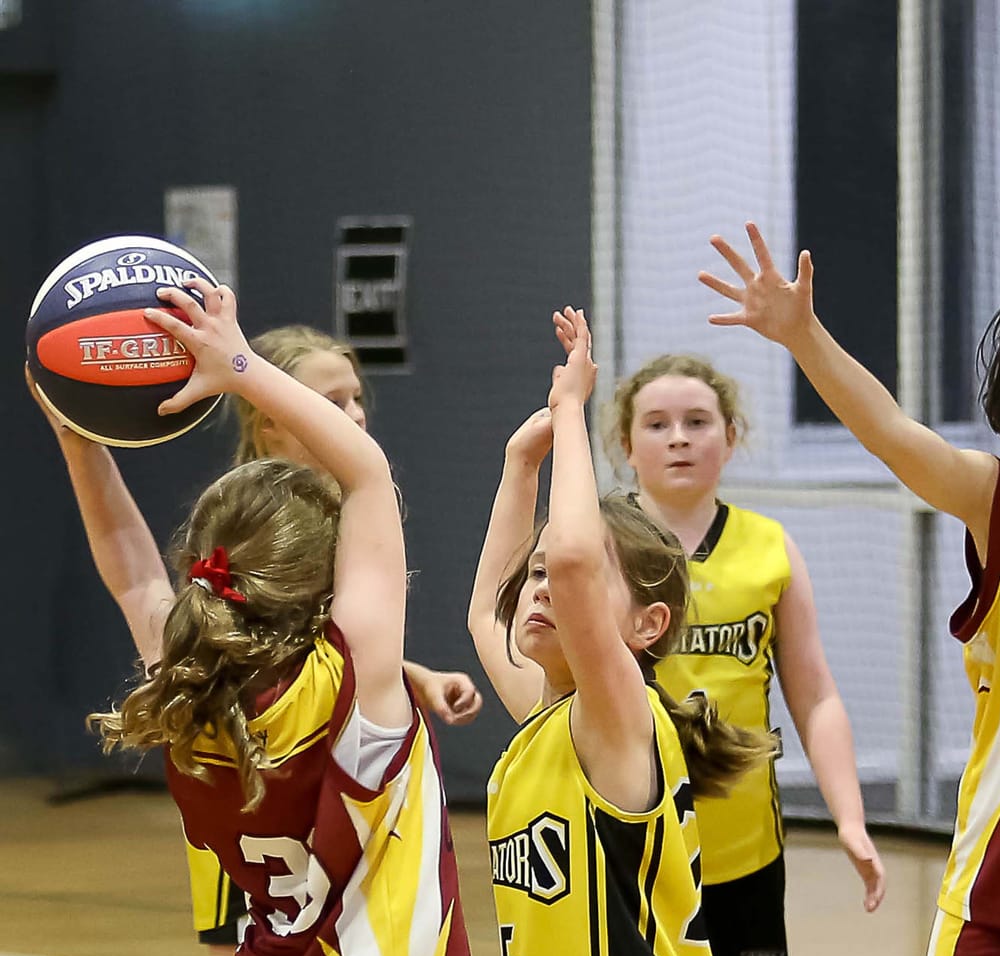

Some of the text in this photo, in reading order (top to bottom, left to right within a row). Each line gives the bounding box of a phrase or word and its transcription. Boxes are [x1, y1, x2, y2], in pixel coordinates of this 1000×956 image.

[100, 359, 189, 371] ALL SURFACE COMPOSIT
